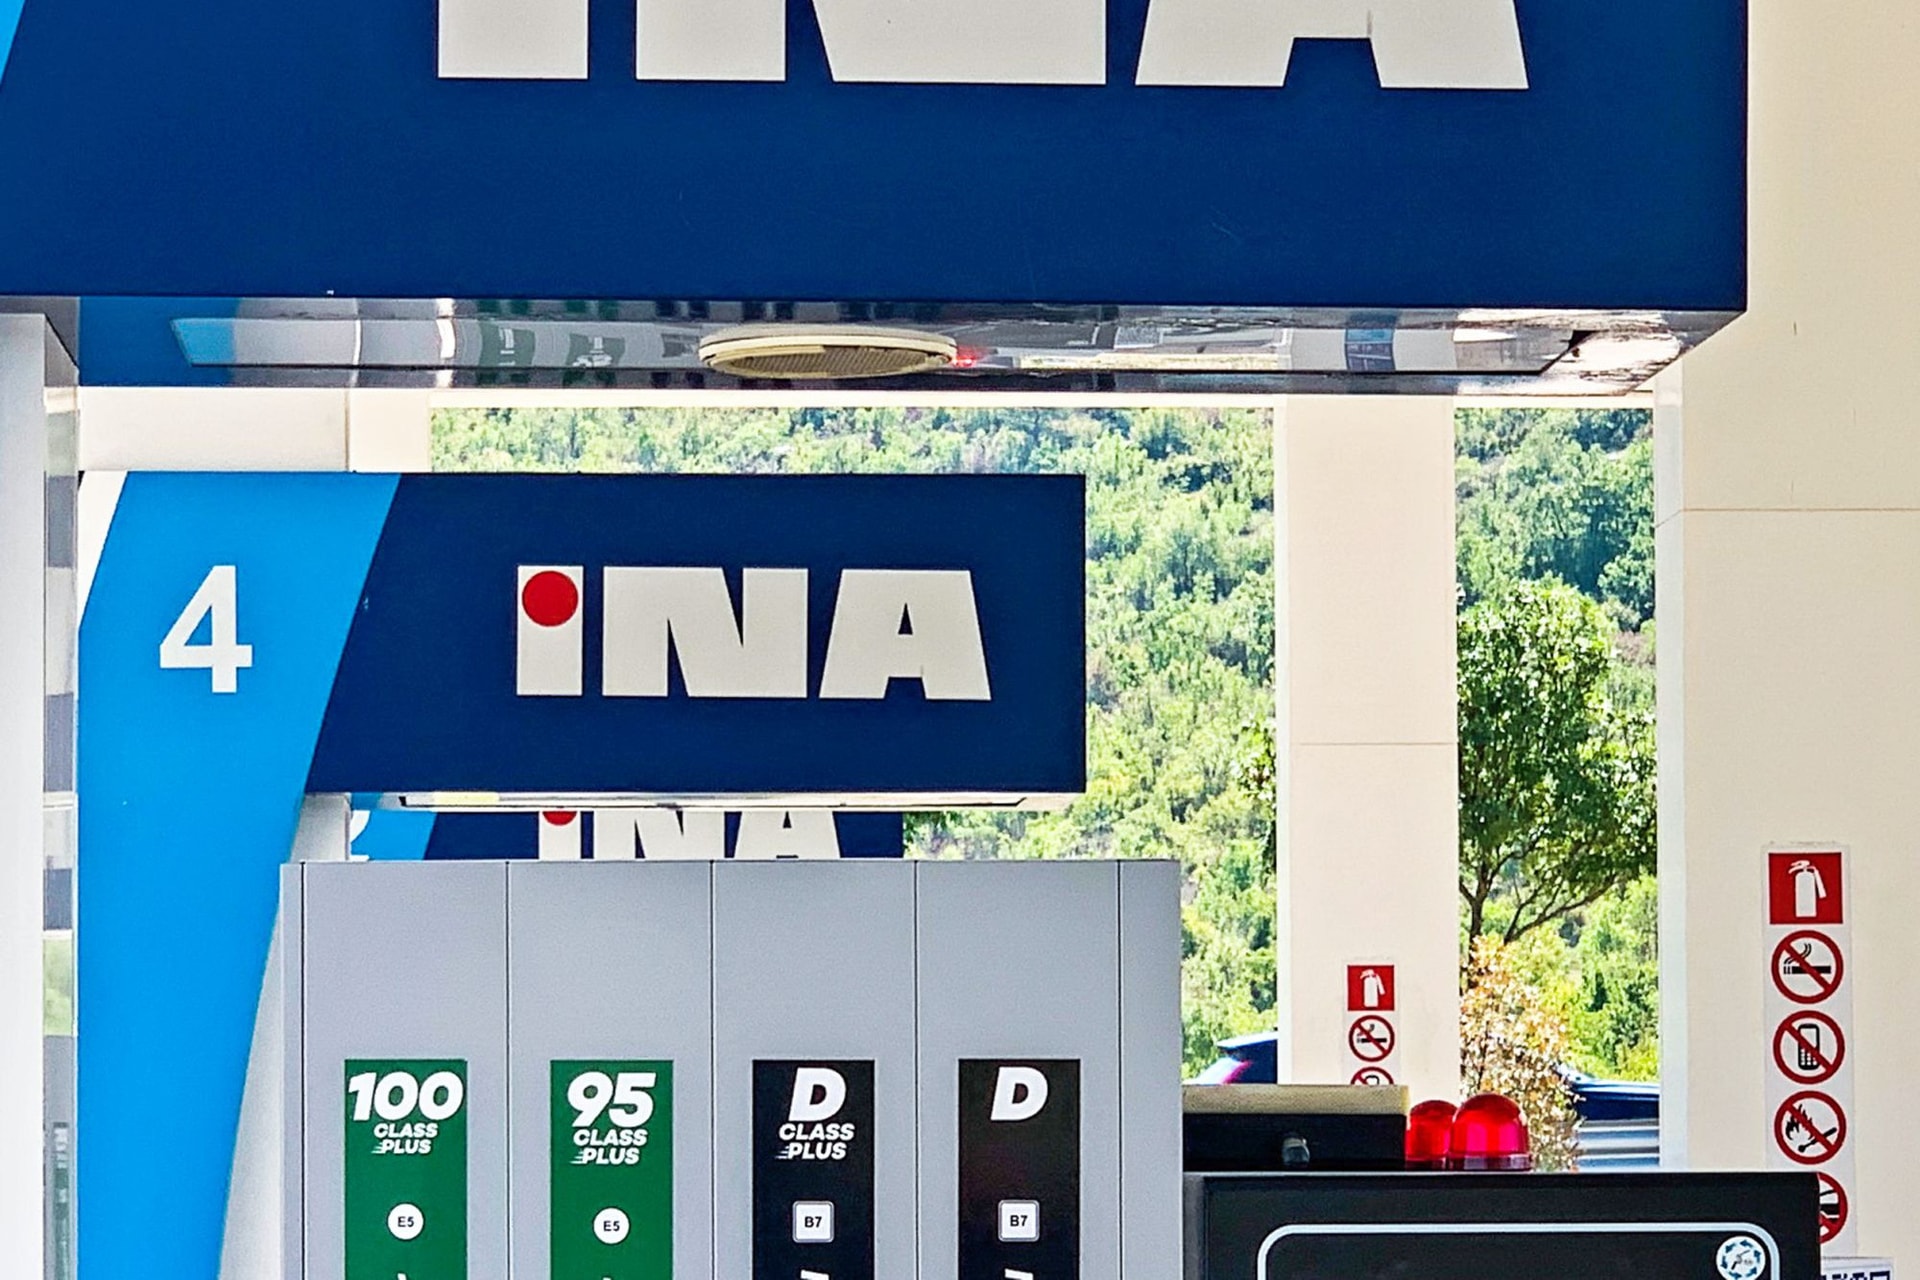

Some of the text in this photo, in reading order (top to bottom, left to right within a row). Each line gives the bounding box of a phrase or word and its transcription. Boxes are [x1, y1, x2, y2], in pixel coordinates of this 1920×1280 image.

[160, 566, 253, 692] 4
[348, 1072, 464, 1121] 100
[567, 1072, 657, 1127] 95
[788, 1067, 847, 1122] D
[990, 1066, 1048, 1121] D
[373, 1123, 438, 1138] CLASS
[573, 1129, 647, 1146] CLASS
[779, 1123, 855, 1141] CLASS
[380, 1138, 432, 1154] PLUS
[786, 1142, 847, 1160] PLUS
[581, 1147, 640, 1165] PLUS
[397, 1216, 415, 1228] E5
[603, 1220, 620, 1232] E5
[804, 1215, 823, 1228] B7
[1009, 1214, 1028, 1227] B7
